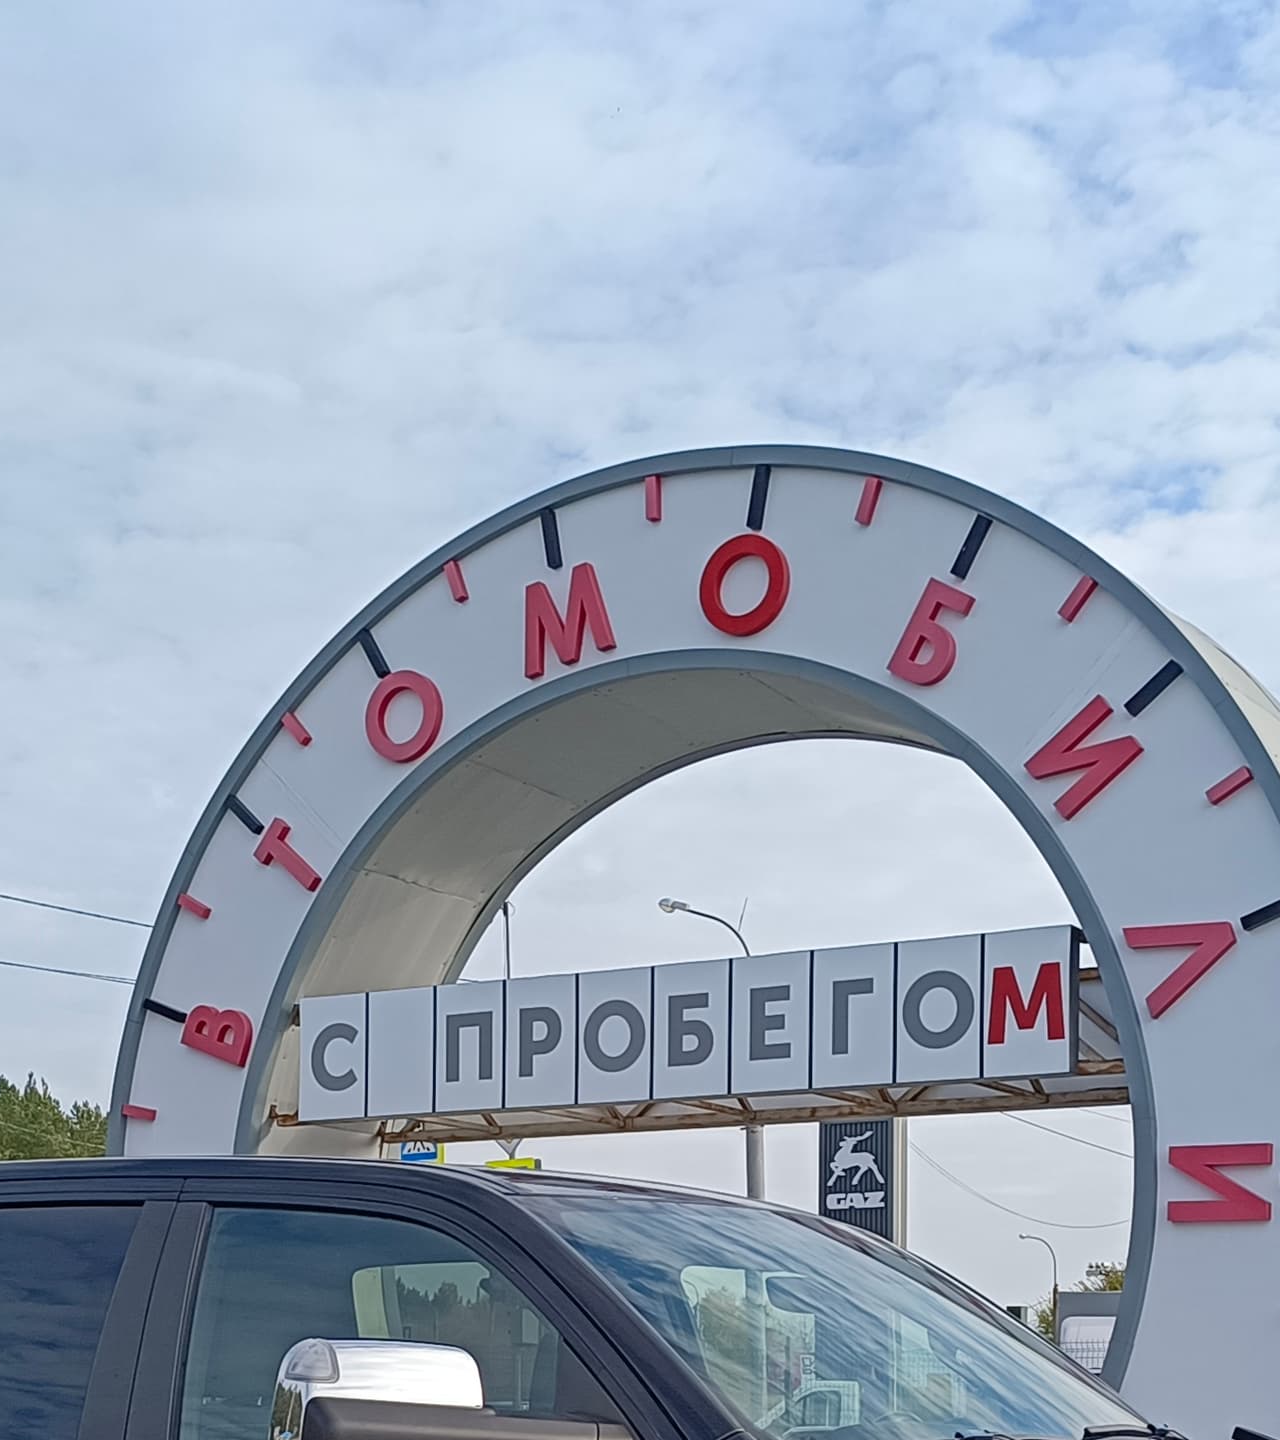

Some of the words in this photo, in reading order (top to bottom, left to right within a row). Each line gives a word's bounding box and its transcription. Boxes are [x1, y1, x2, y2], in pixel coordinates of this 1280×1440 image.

[180, 532, 1274, 1225] ВТОМОБИЛИ
[310, 1022, 359, 1092] С
[444, 961, 1067, 1084] ПРОБЕГОМ
[825, 1191, 886, 1210] GAZ
